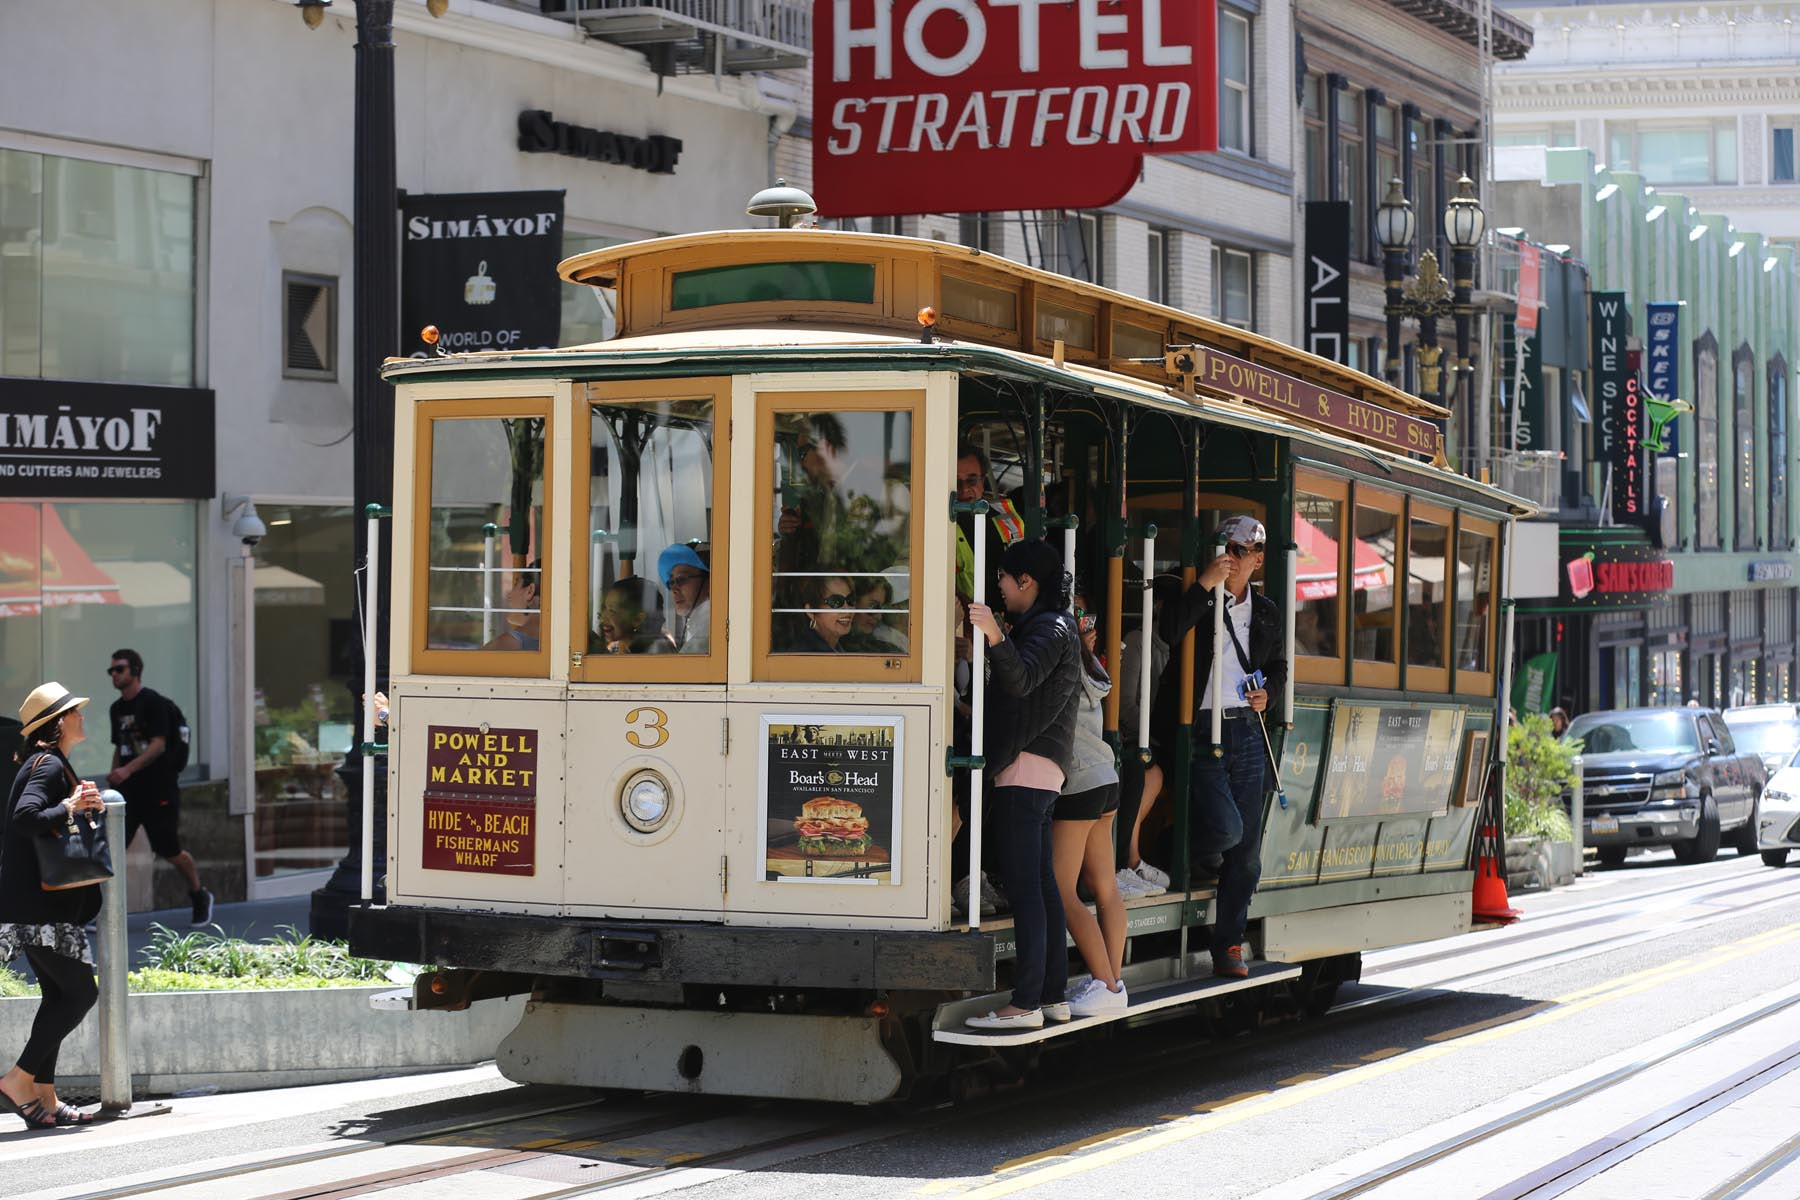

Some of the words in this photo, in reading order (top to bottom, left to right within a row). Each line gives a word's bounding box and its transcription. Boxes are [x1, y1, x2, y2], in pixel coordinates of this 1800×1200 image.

[833, 0, 1192, 82] HOTEL
[827, 82, 1191, 155] STRATFORD
[437, 331, 492, 347] WORLD
[496, 330, 521, 344] OF
[1599, 301, 1618, 372] WINE
[1210, 356, 1300, 409] POWELL
[1318, 393, 1331, 417] &
[1347, 403, 1398, 439] HYDE
[1407, 423, 1433, 449] Sts.
[1626, 378, 1638, 513] COCKTAILS
[18, 465, 72, 478] CUTTERS
[75, 467, 99, 478] AND
[101, 467, 162, 479] JEWELERS
[625, 706, 669, 749] 3
[1387, 716, 1401, 728] EAST
[434, 732, 533, 753] POWELL
[458, 753, 508, 767] AND
[781, 748, 819, 759] EAST
[847, 750, 889, 761] WEST
[1293, 741, 1308, 776] 3
[431, 766, 533, 787] MARKET
[789, 770, 825, 785] Boar's
[844, 772, 879, 786] Head
[428, 810, 462, 831] HYDE
[484, 814, 529, 835] BEACH
[436, 835, 519, 853] FISHERMANS
[455, 851, 498, 867] WHARF
[1287, 850, 1310, 871] SAN
